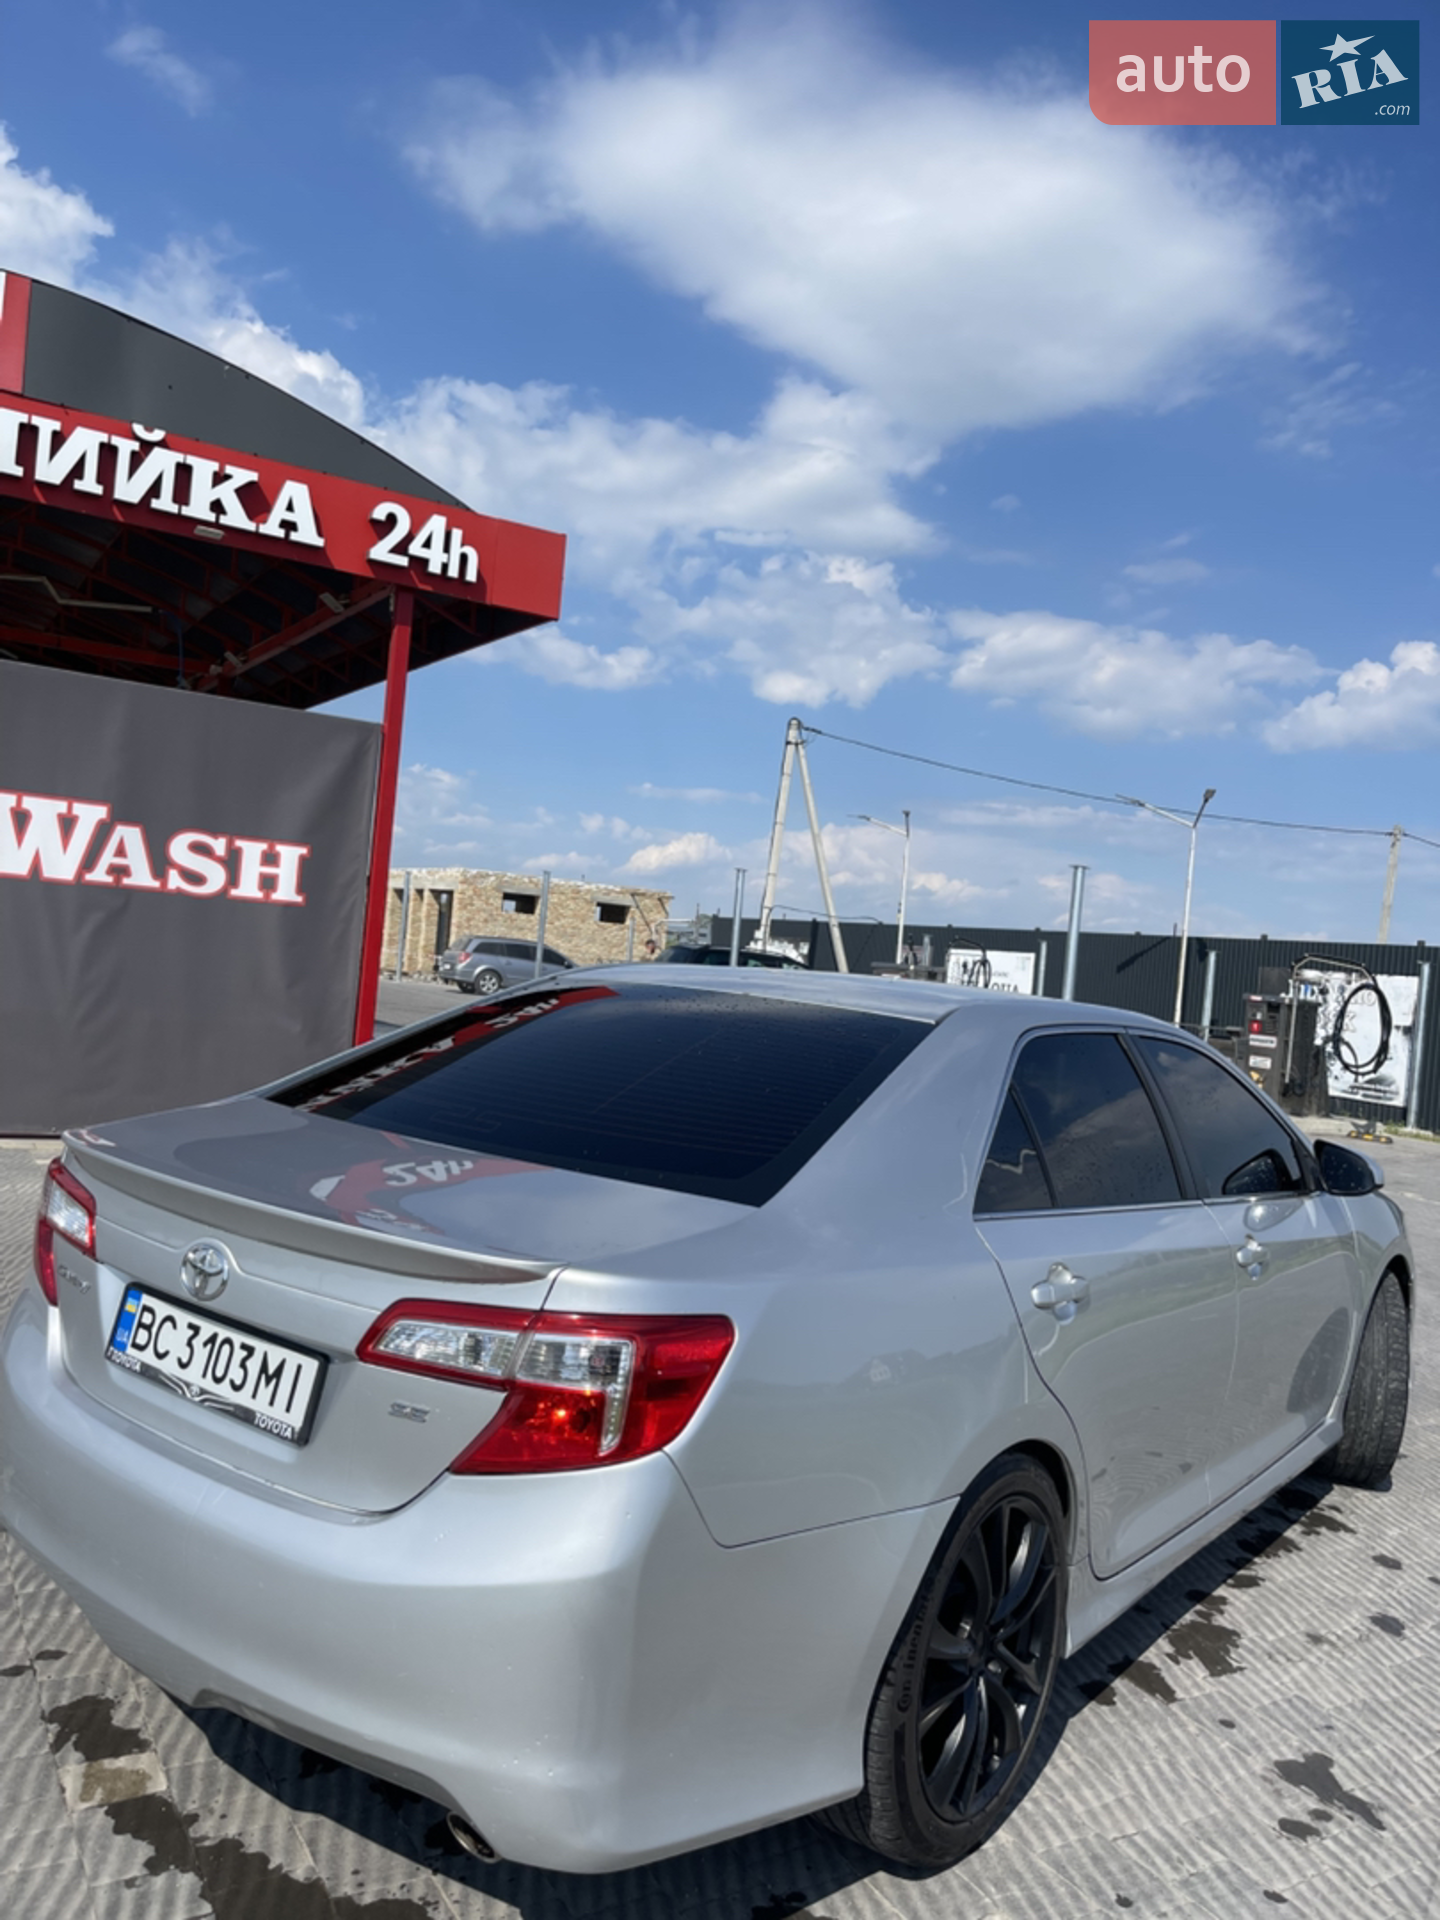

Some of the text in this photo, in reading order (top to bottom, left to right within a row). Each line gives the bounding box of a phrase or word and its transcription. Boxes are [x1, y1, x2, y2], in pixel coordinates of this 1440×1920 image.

[367, 501, 479, 583] 24h
[0, 791, 311, 905] WASH
[254, 1411, 293, 1439] TOYOTA
